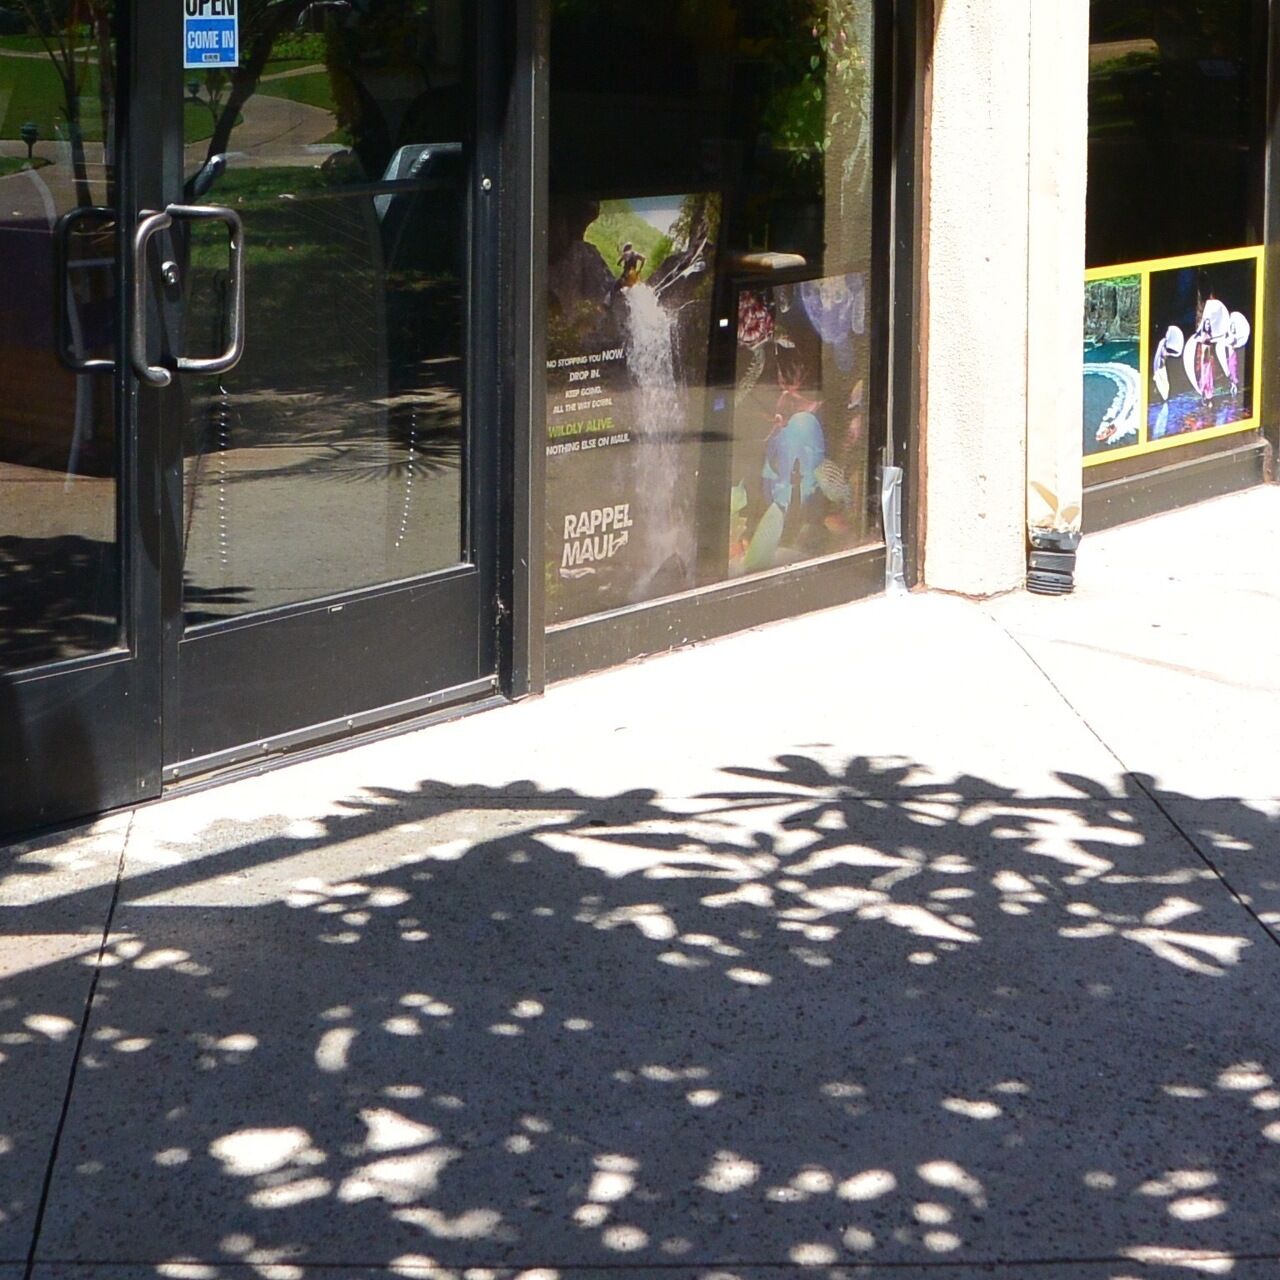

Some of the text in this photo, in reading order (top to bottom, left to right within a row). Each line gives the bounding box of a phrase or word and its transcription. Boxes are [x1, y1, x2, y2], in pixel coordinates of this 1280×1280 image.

[187, 30, 234, 49] COME IN
[546, 360, 557, 368] NO
[558, 356, 588, 368] STOPPING
[589, 354, 601, 364] YOU
[569, 371, 589, 382] DROP
[565, 402, 577, 412] THE
[549, 421, 584, 438] WILDLY
[546, 441, 580, 456] NOTHING
[581, 438, 597, 450] ELSE
[598, 436, 609, 447] ON
[563, 504, 633, 539] RAPPEL
[561, 533, 617, 568] MAUI
